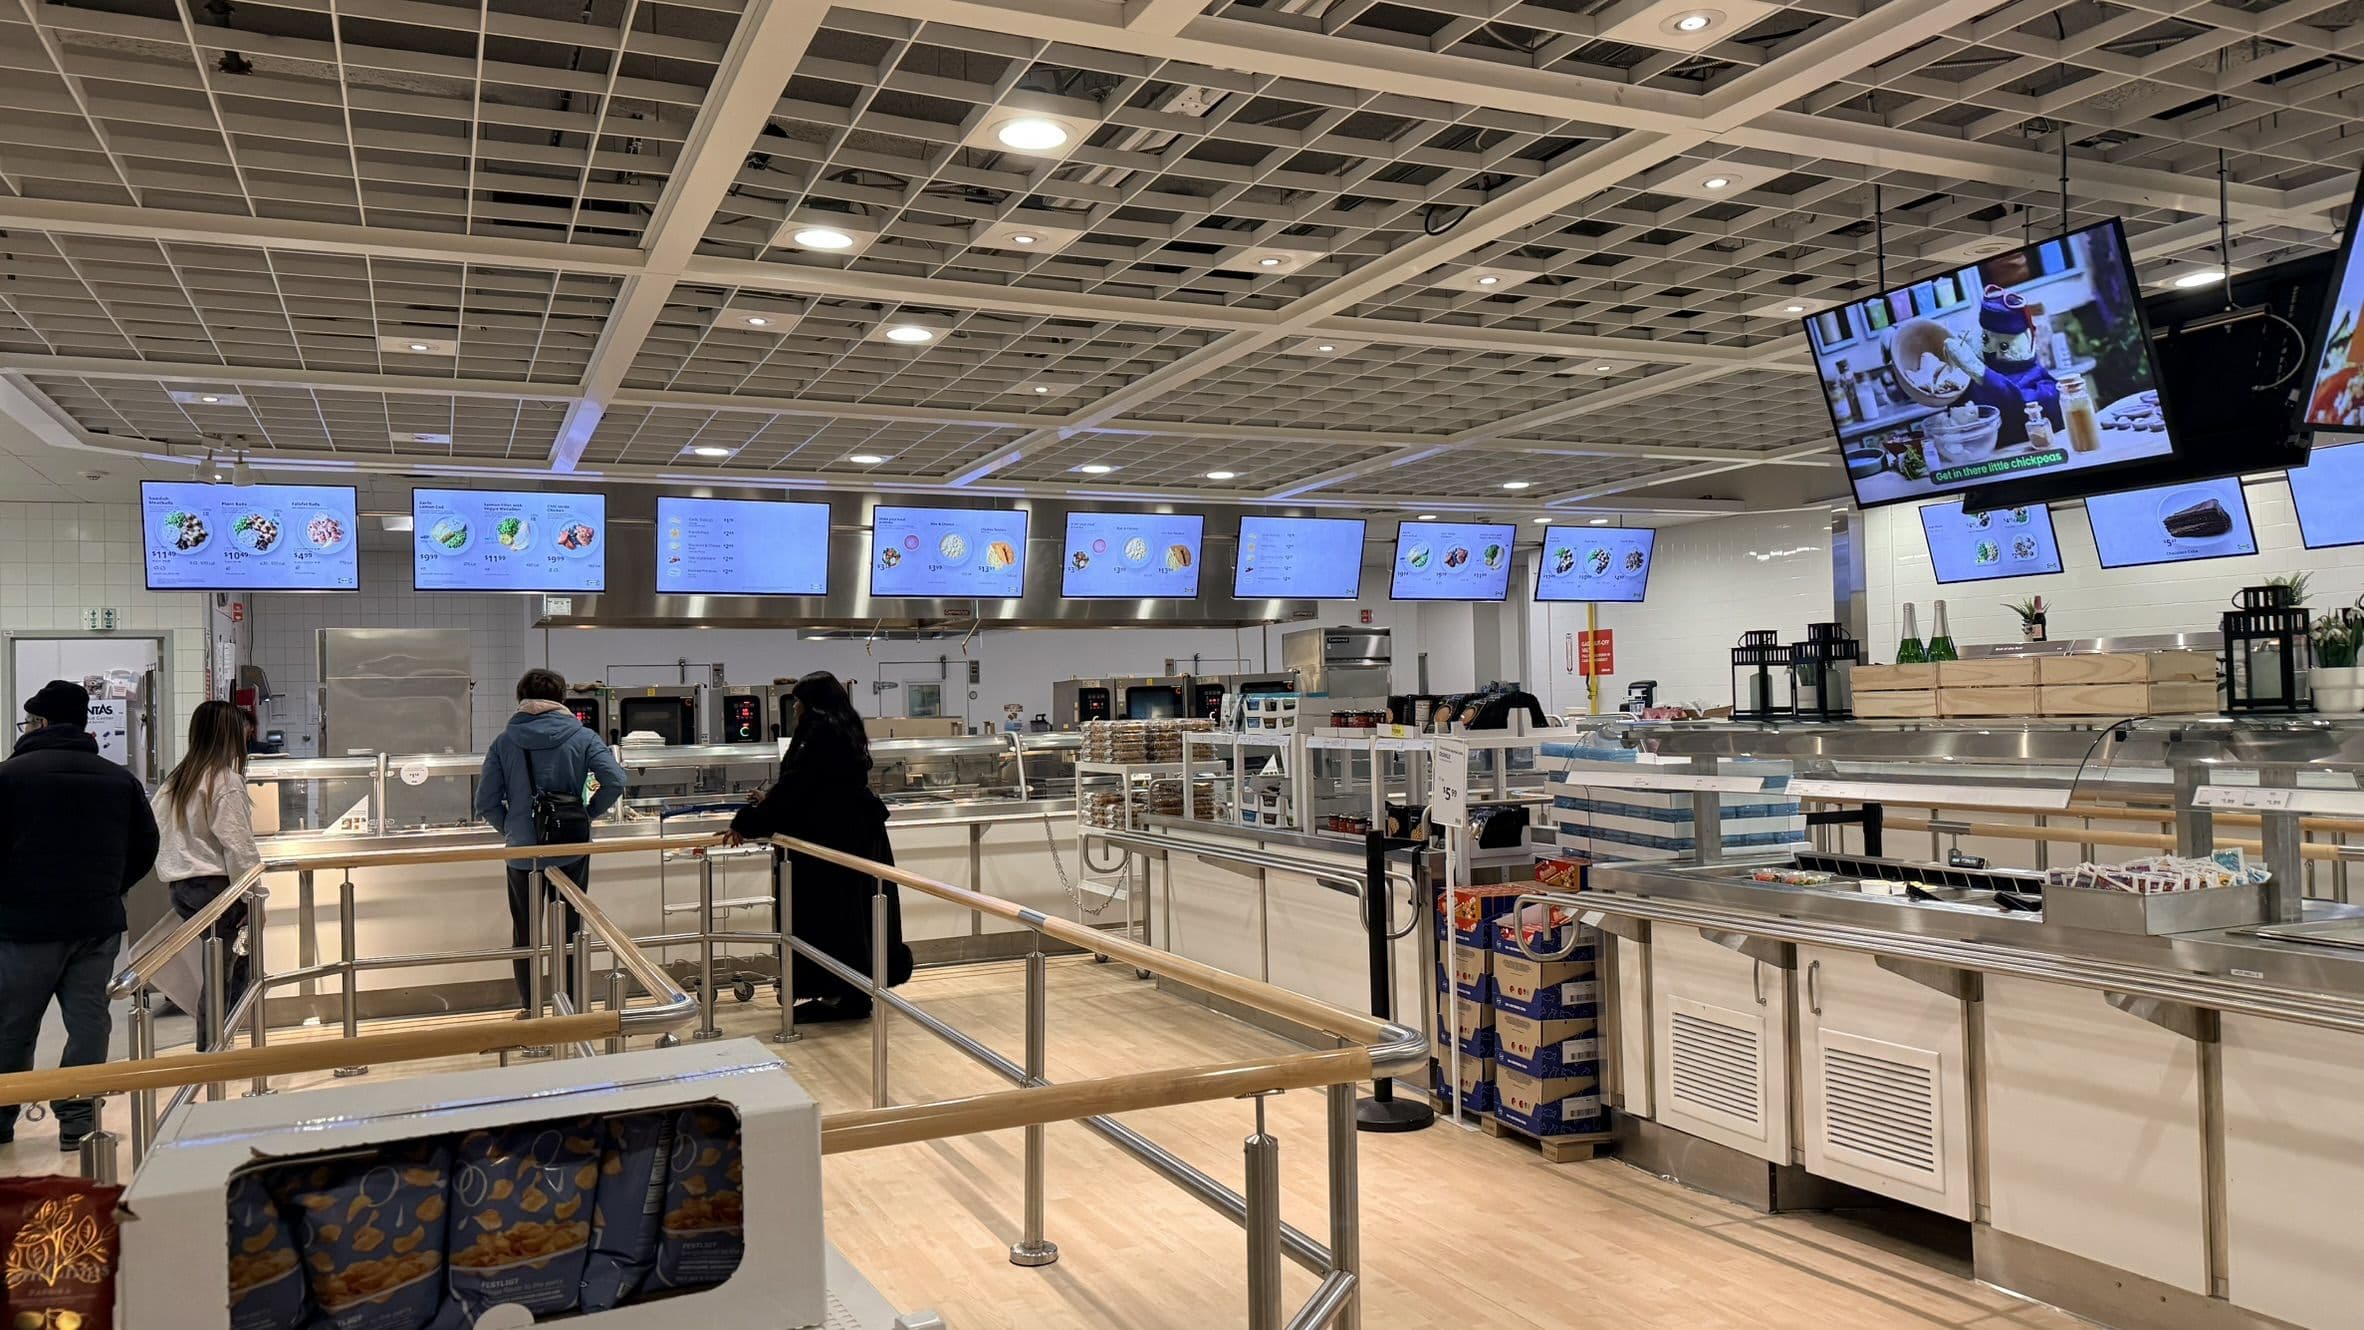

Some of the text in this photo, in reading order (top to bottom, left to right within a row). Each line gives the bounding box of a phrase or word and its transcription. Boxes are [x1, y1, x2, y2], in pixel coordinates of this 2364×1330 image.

[1935, 452, 2063, 482] Get in there little chickpeas
[87, 703, 114, 715] NTAS
